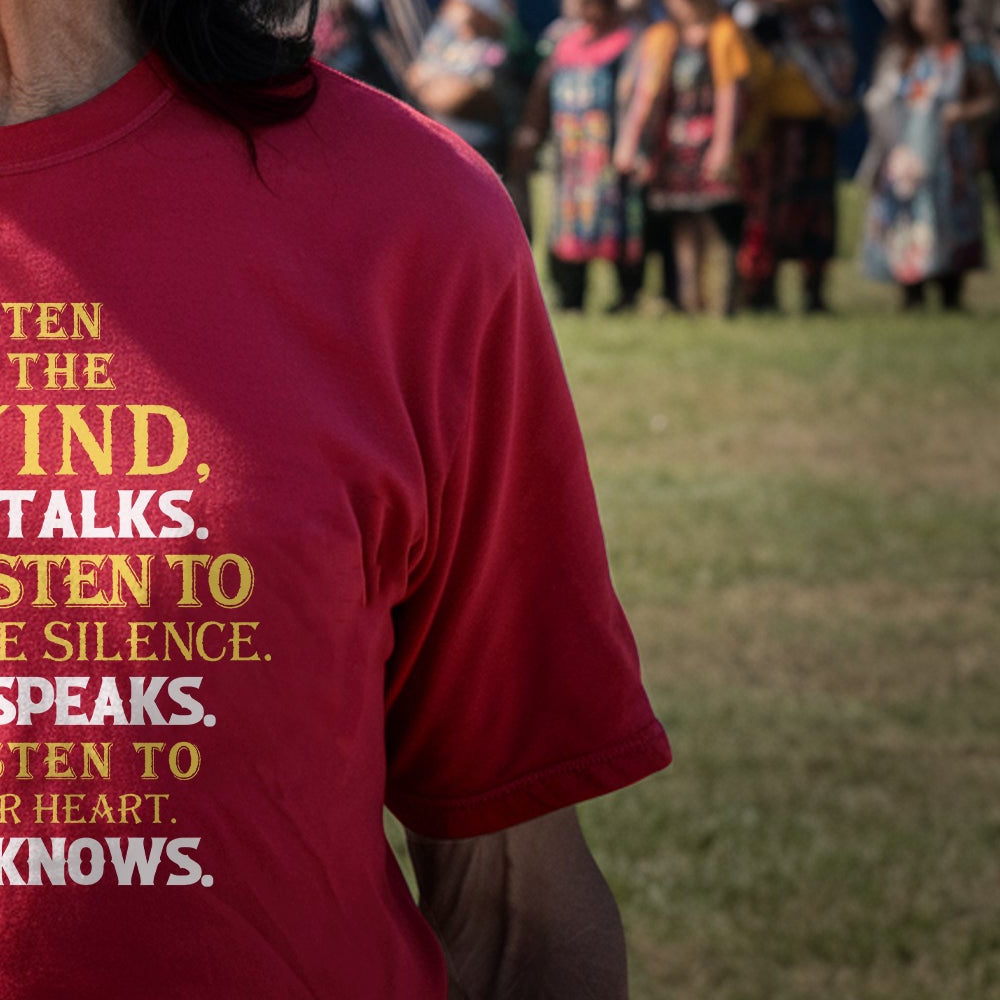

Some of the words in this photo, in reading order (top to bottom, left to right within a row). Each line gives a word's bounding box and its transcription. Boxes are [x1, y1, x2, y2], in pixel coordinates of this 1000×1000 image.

[8, 353, 116, 390] THE
[166, 554, 254, 608] TO
[43, 621, 271, 661] SILENCE.
[134, 742, 200, 780] TO
[33, 794, 176, 823] HEART.
